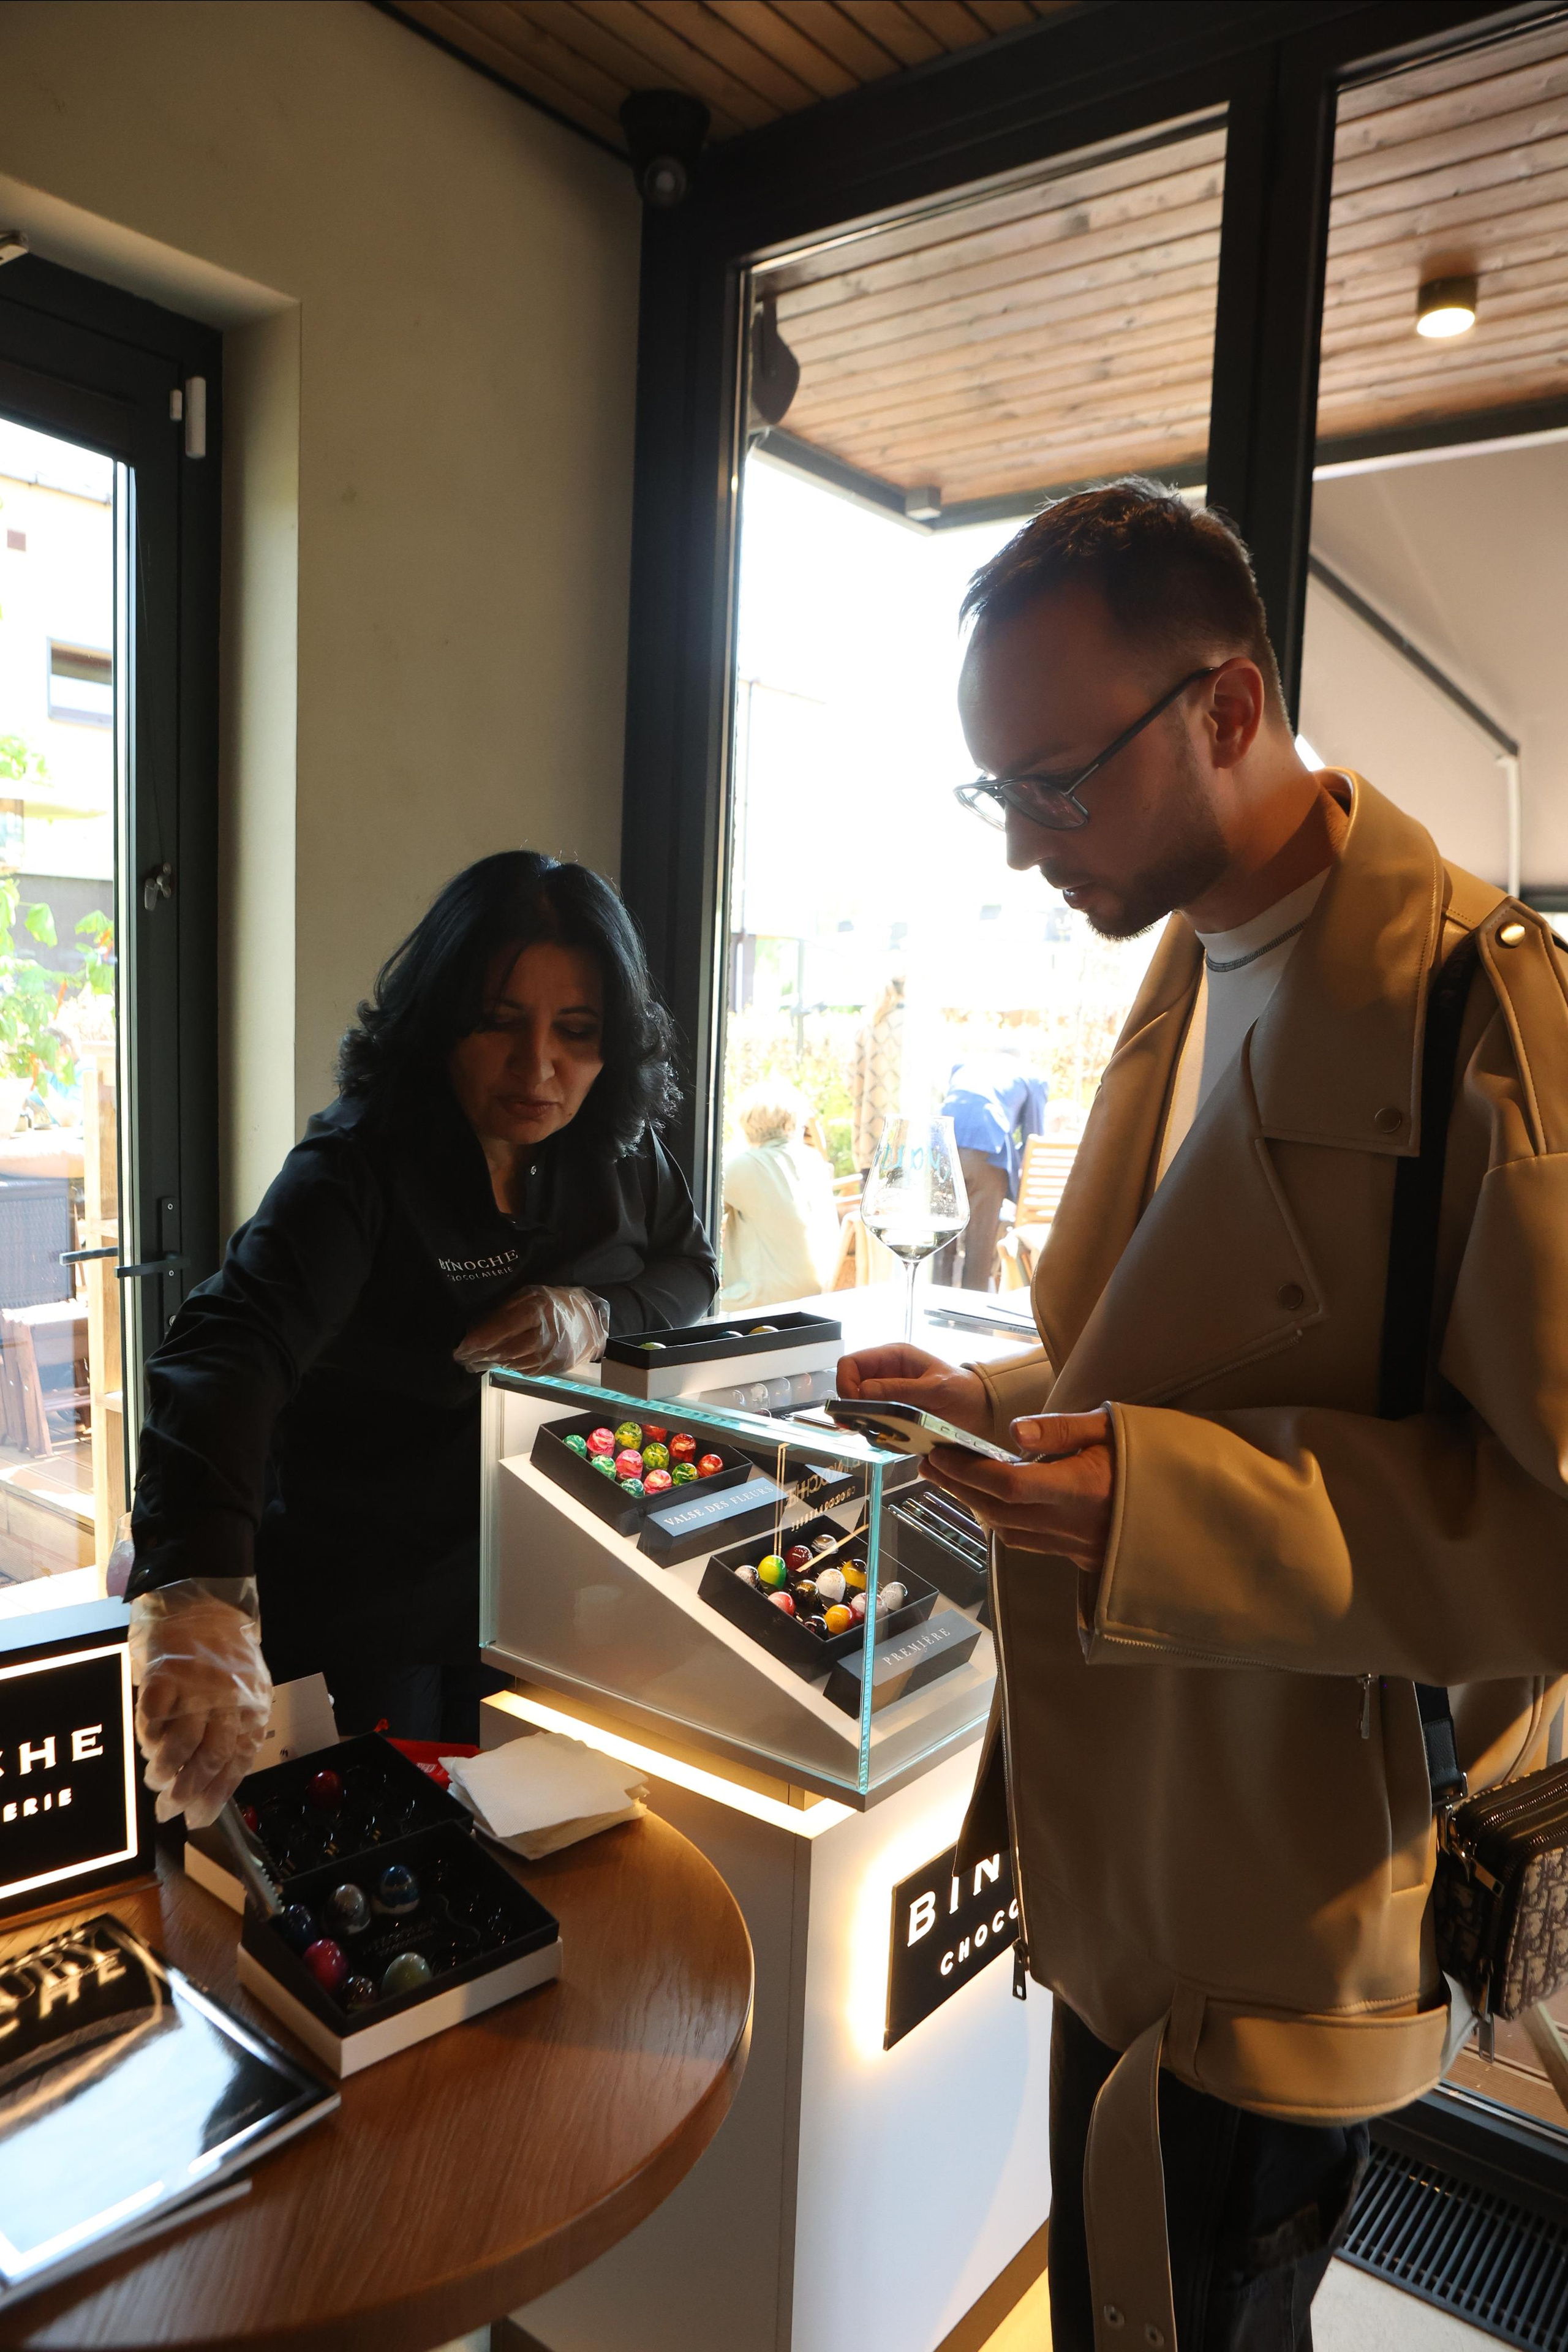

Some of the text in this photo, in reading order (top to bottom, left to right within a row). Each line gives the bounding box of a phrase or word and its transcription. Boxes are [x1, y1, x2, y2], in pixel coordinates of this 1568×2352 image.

[663, 1485, 774, 1526] VALSE DES FLEURS
[882, 1627, 951, 1666] PREMIÈRE
[907, 1853, 1000, 1948] BIN
